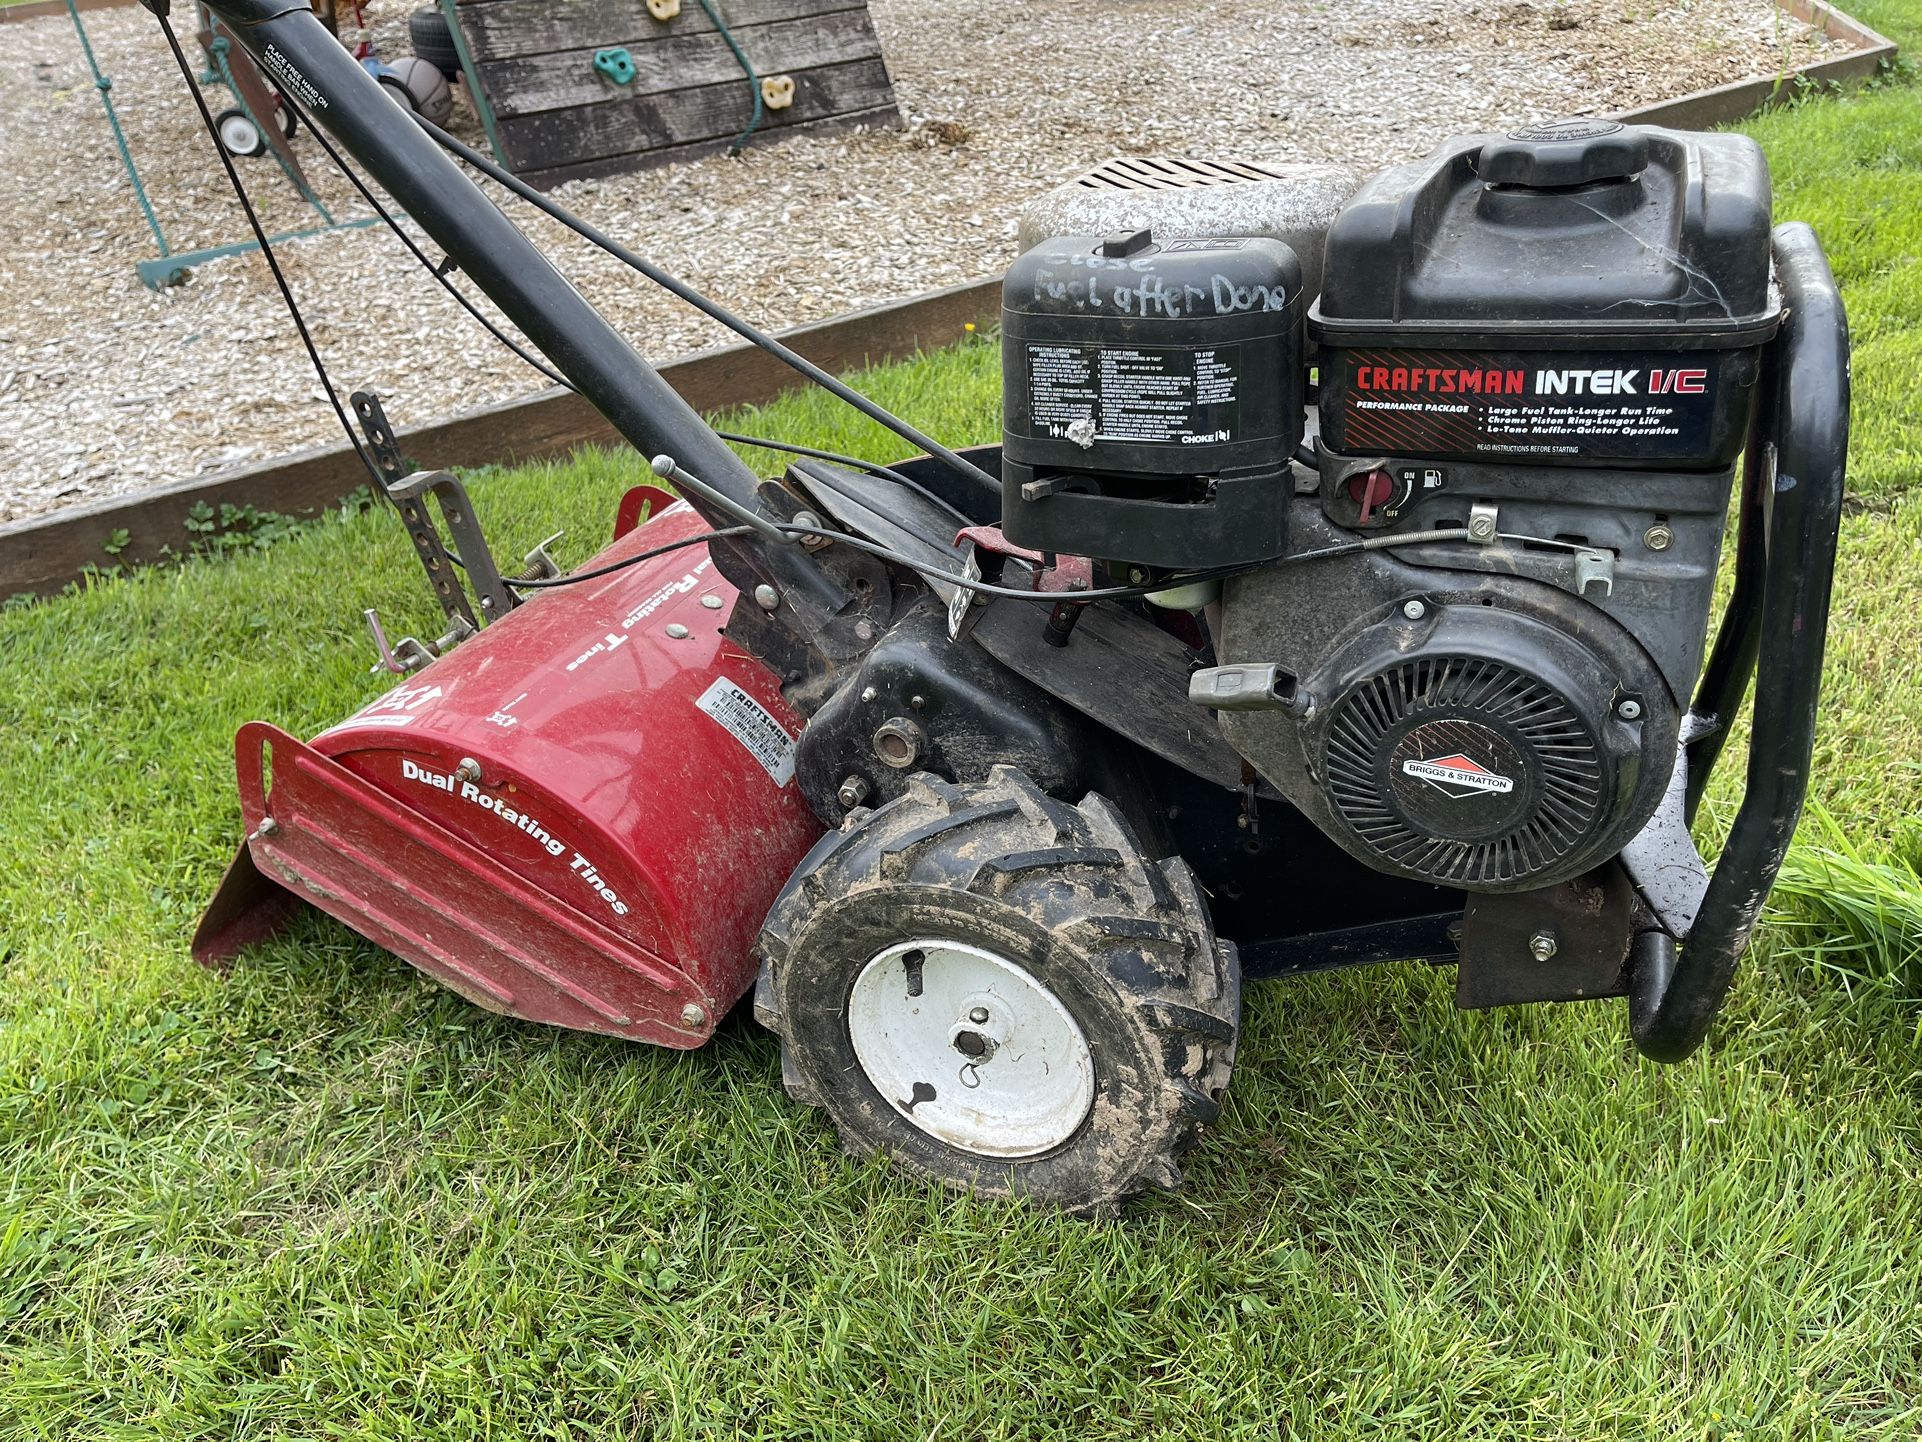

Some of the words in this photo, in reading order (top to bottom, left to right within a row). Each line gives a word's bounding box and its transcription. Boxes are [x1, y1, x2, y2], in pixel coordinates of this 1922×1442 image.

[265, 50, 288, 75] HANDLE
[288, 73, 300, 88] BAR
[300, 86, 318, 106] WHEN
[268, 44, 288, 65] PLACE
[286, 63, 302, 81] FREE
[302, 79, 318, 98] HAND
[318, 97, 328, 108] ON
[1357, 366, 1525, 395] CRAFTSMAN
[1535, 369, 1639, 395] INTEK
[1356, 401, 1423, 411] PERFORMANCE
[1425, 404, 1470, 413] PACKAGE
[1488, 406, 1518, 417] Large
[1521, 406, 1545, 415] Fuel
[1548, 406, 1617, 417] Tank-Longer
[1620, 407, 1642, 415] Run
[1645, 407, 1673, 415] Time
[1487, 416, 1527, 425] Chrome
[1530, 416, 1564, 425] Piston
[1567, 416, 1635, 426] Ring-Longer
[1638, 417, 1660, 425] Life
[1487, 425, 1529, 434] Lo-Tone
[1531, 425, 1618, 435] Muffler-Quieter
[1621, 426, 1679, 436] Operation
[1182, 435, 1214, 443] CHOKE
[1492, 444, 1529, 453] INSTRUCTIONS
[622, 574, 699, 629] Rotating
[731, 689, 789, 746] CRAFTSMAN
[1409, 764, 1446, 777] BRIGGS
[1457, 773, 1507, 788] STRATTON
[402, 759, 454, 792] Dual
[460, 781, 567, 857] Rotating
[569, 852, 629, 917] Tines
